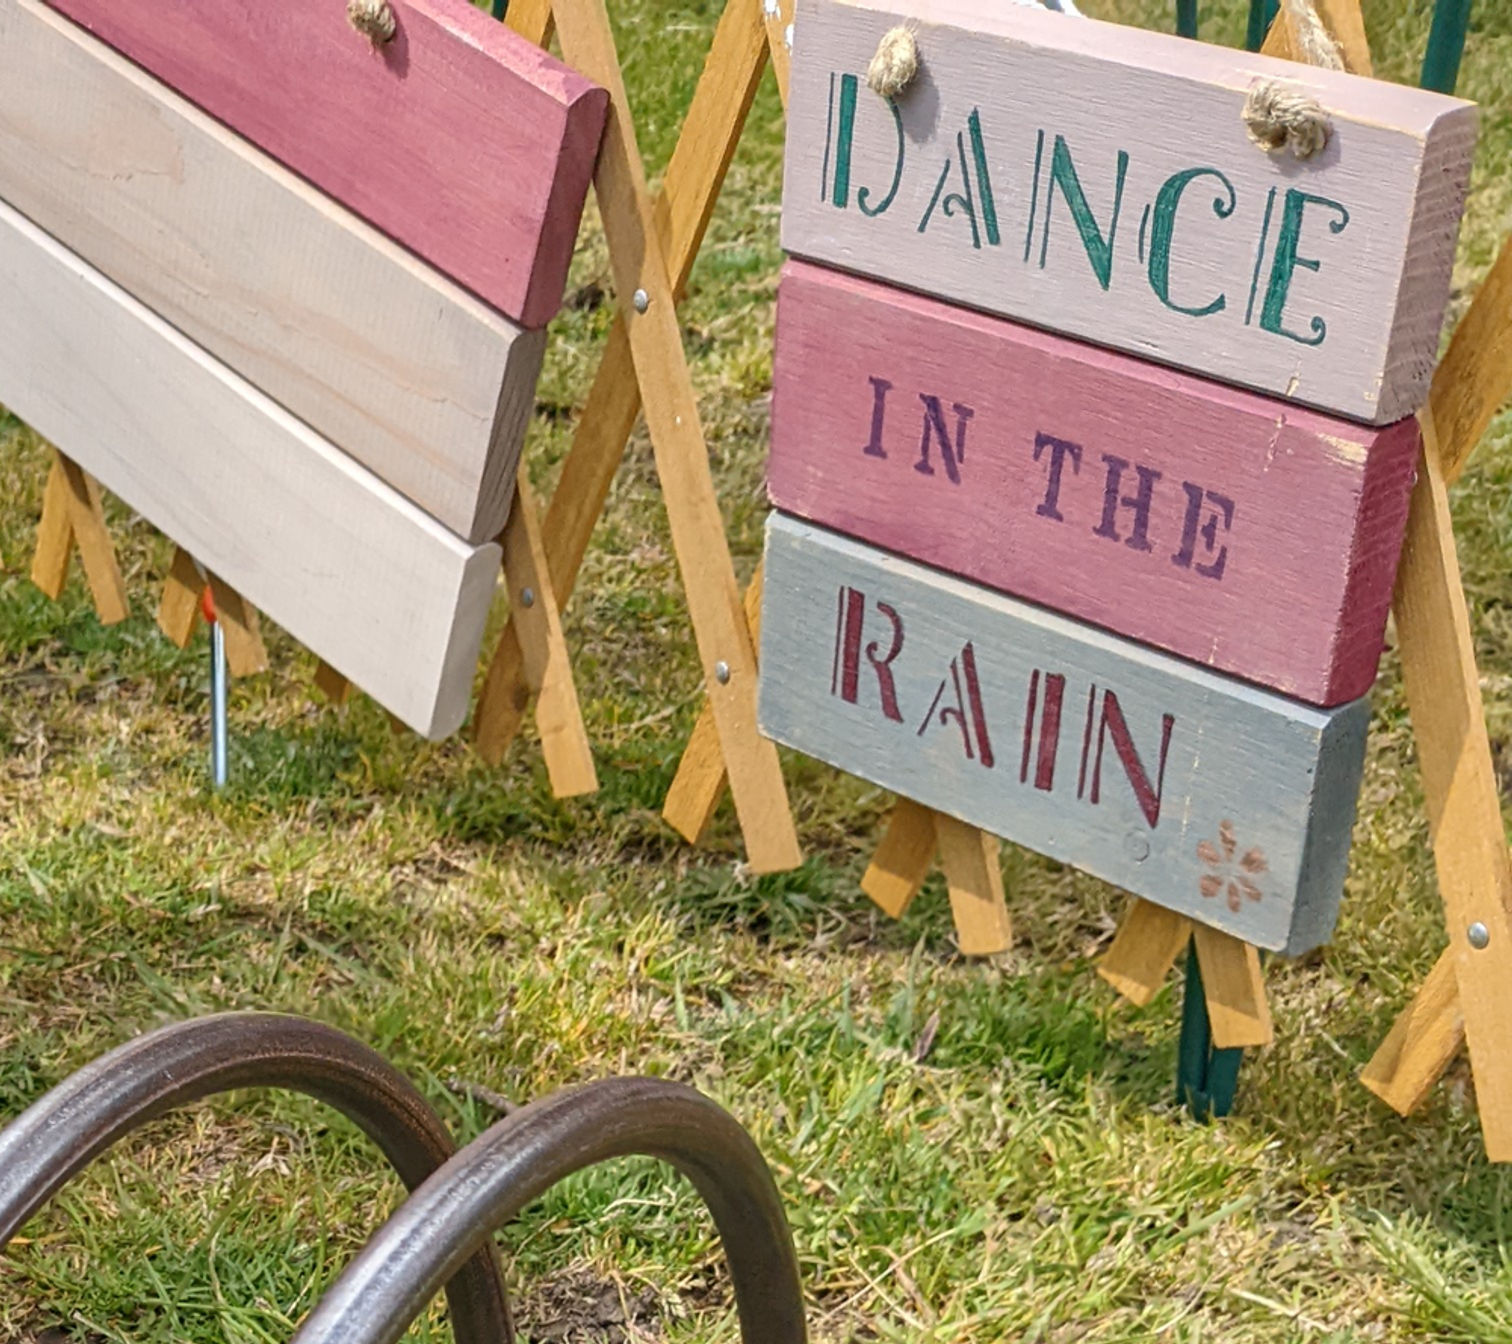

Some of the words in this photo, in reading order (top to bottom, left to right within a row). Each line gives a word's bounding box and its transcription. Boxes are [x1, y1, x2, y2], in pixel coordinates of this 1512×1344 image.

[821, 73, 1349, 345] DANCE
[864, 375, 974, 486] IN
[1032, 430, 1235, 580] THE
[830, 586, 1175, 829] RAIN
